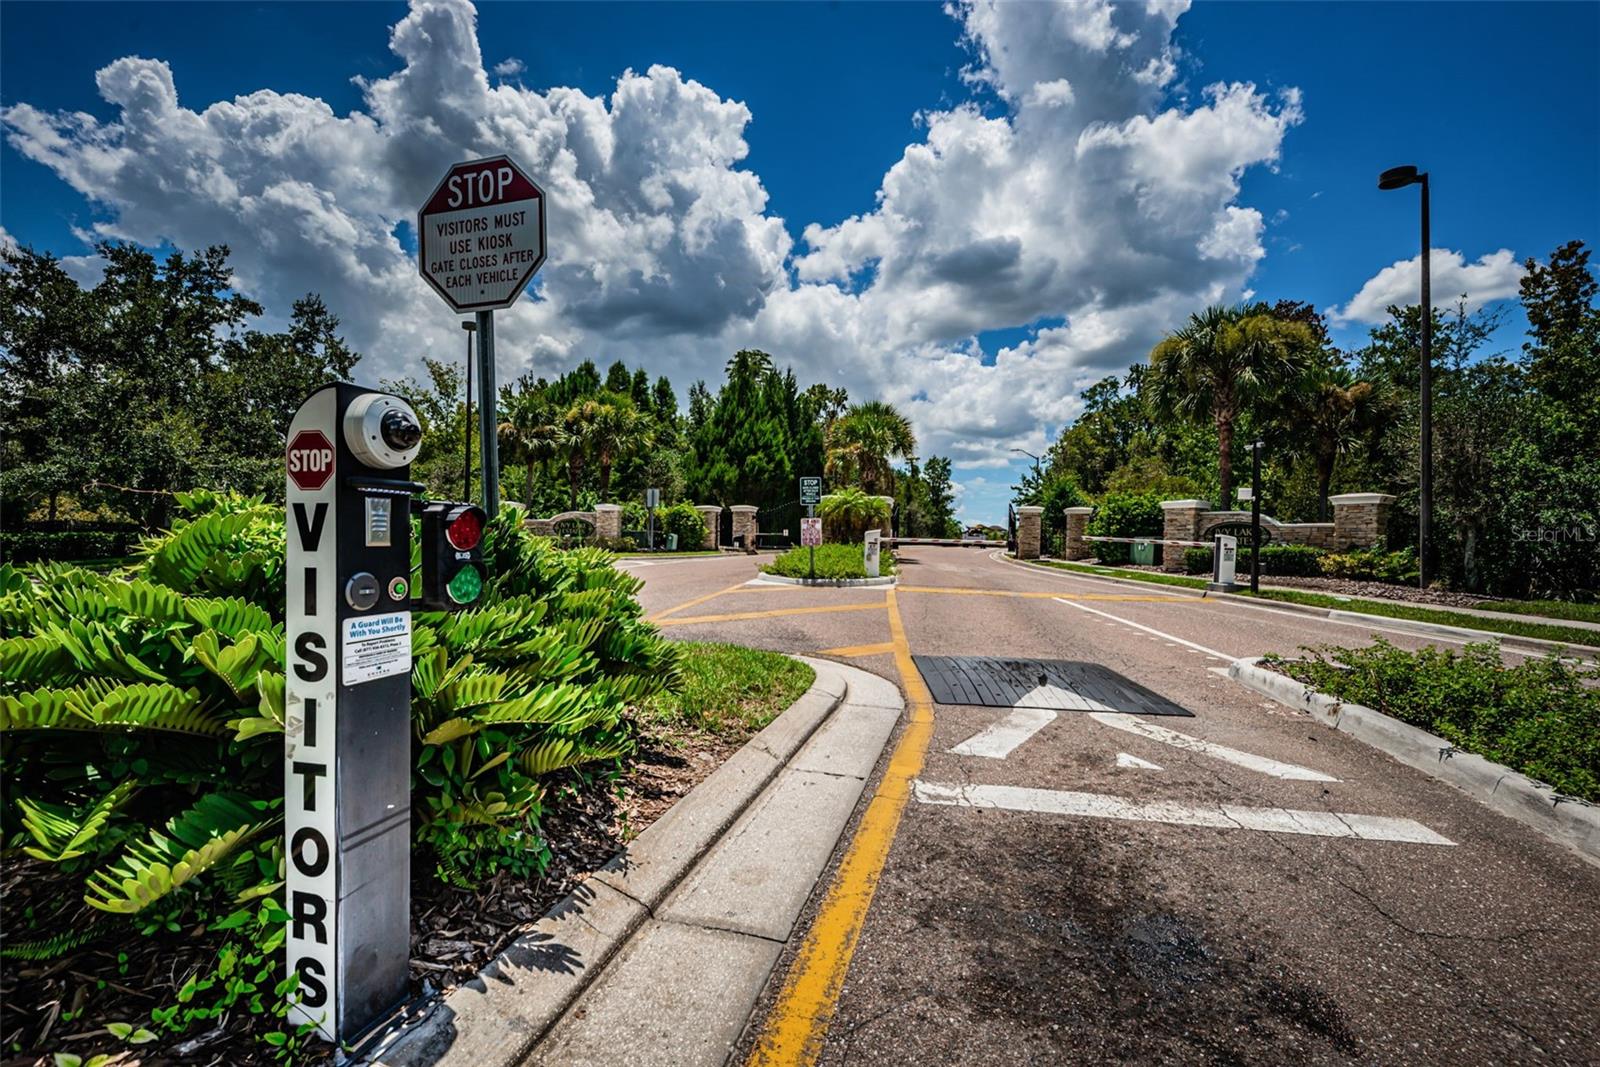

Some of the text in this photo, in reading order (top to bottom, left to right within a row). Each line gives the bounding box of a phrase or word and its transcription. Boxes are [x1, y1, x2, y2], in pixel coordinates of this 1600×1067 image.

[448, 167, 513, 207] STOP
[437, 211, 526, 236] VISITORS MUST
[450, 233, 512, 254] USE KIOSK
[431, 250, 534, 274] GATE CLOSES AFTER
[446, 268, 519, 288] EACH VEHICLE
[290, 449, 332, 473] STOP
[350, 630, 366, 638] With
[382, 624, 405, 633] Shortly
[358, 619, 380, 628] Guard
[381, 617, 394, 625] Will
[291, 503, 328, 1008] VISITORS
